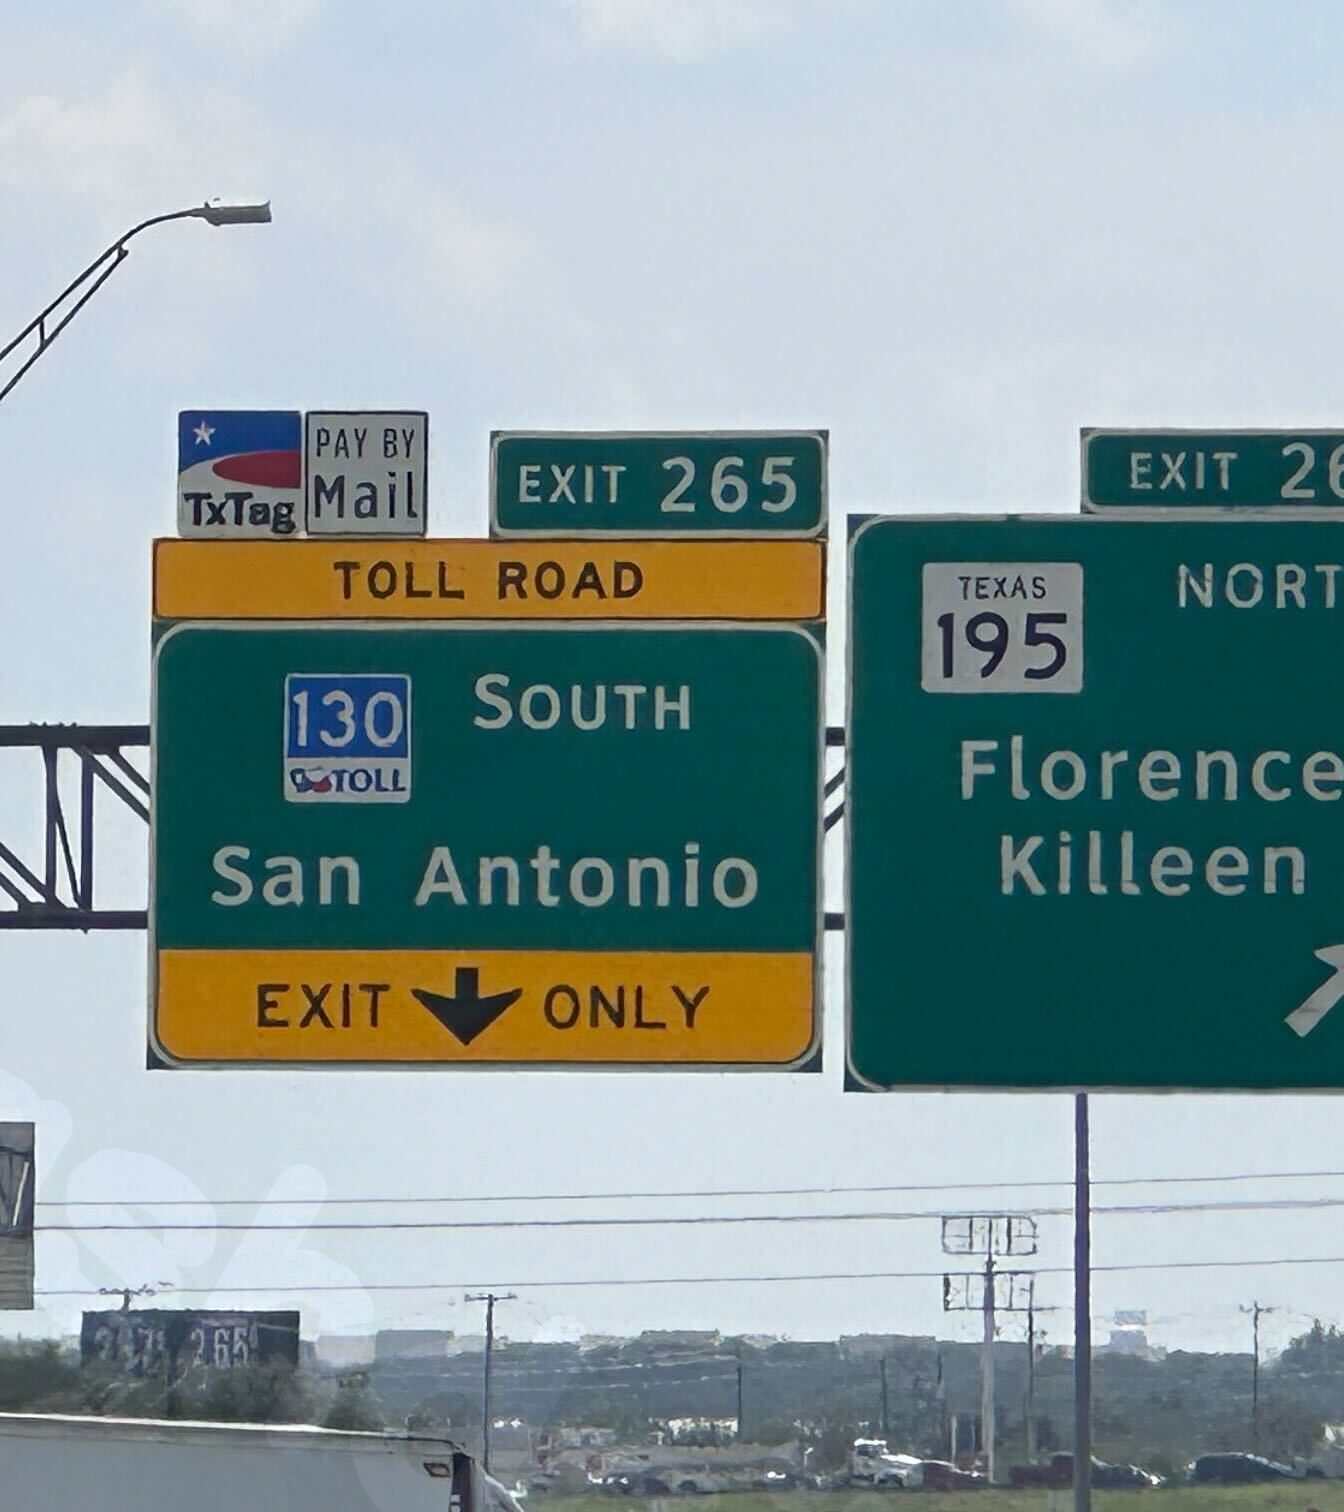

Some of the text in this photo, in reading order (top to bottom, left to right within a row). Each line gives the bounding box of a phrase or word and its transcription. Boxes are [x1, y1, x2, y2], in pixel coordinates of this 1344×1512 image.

[317, 428, 414, 458] PAY BY
[520, 457, 796, 512] EXIT 265
[1131, 452, 1237, 490] EXIT
[184, 492, 296, 534] TxTag
[315, 472, 417, 518] Mail
[334, 561, 643, 599] TOLL ROAD
[959, 576, 1046, 600] TEXAS
[938, 612, 1067, 679] 195
[293, 690, 402, 747] 130
[474, 674, 689, 730] SOUTH
[331, 768, 406, 792] TOLL
[962, 735, 1344, 801] Florence
[212, 843, 757, 907] San Antonio
[1001, 831, 1304, 896] Killeen
[258, 984, 709, 1029] EXIT ONLY
